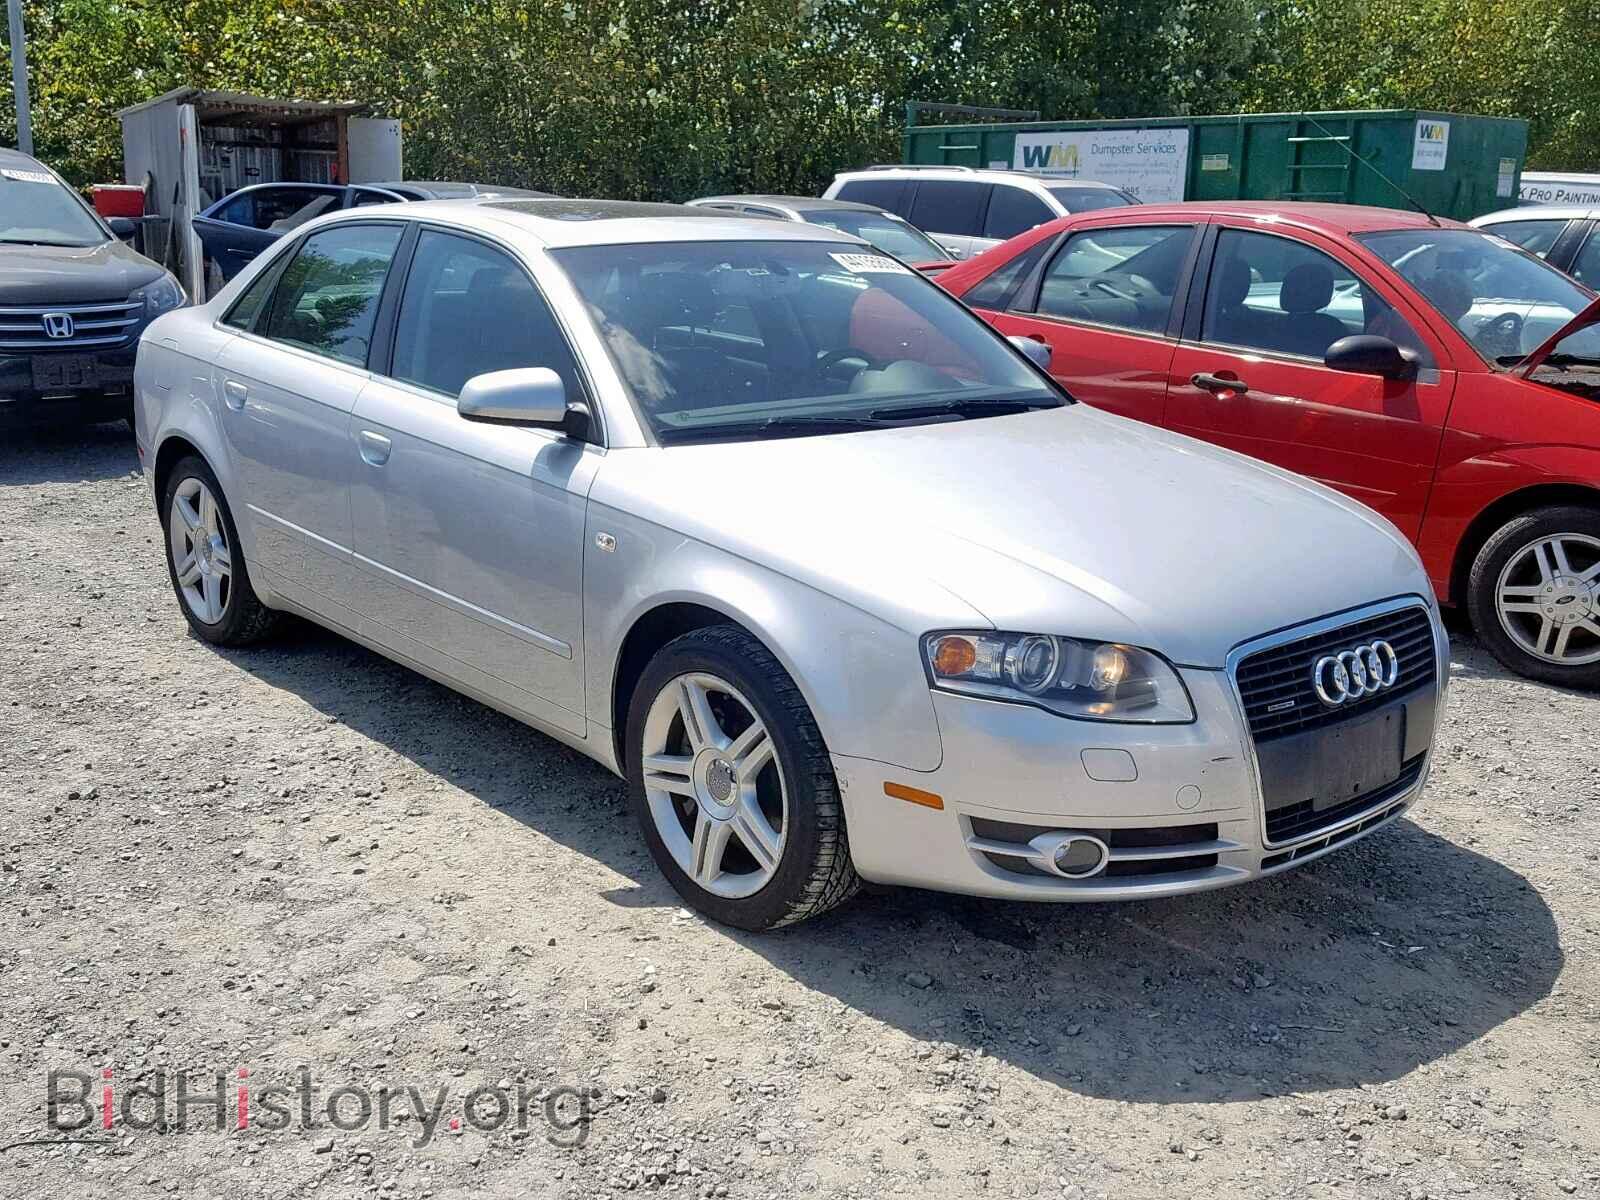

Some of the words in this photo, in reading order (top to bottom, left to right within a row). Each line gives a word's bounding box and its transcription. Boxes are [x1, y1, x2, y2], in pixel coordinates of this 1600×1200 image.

[1023, 144, 1078, 168] WM
[1091, 143, 1134, 156] Dumpster
[1137, 142, 1176, 153] Services
[1529, 188, 1551, 200] PRO
[1555, 190, 1600, 203] PAINTIN
